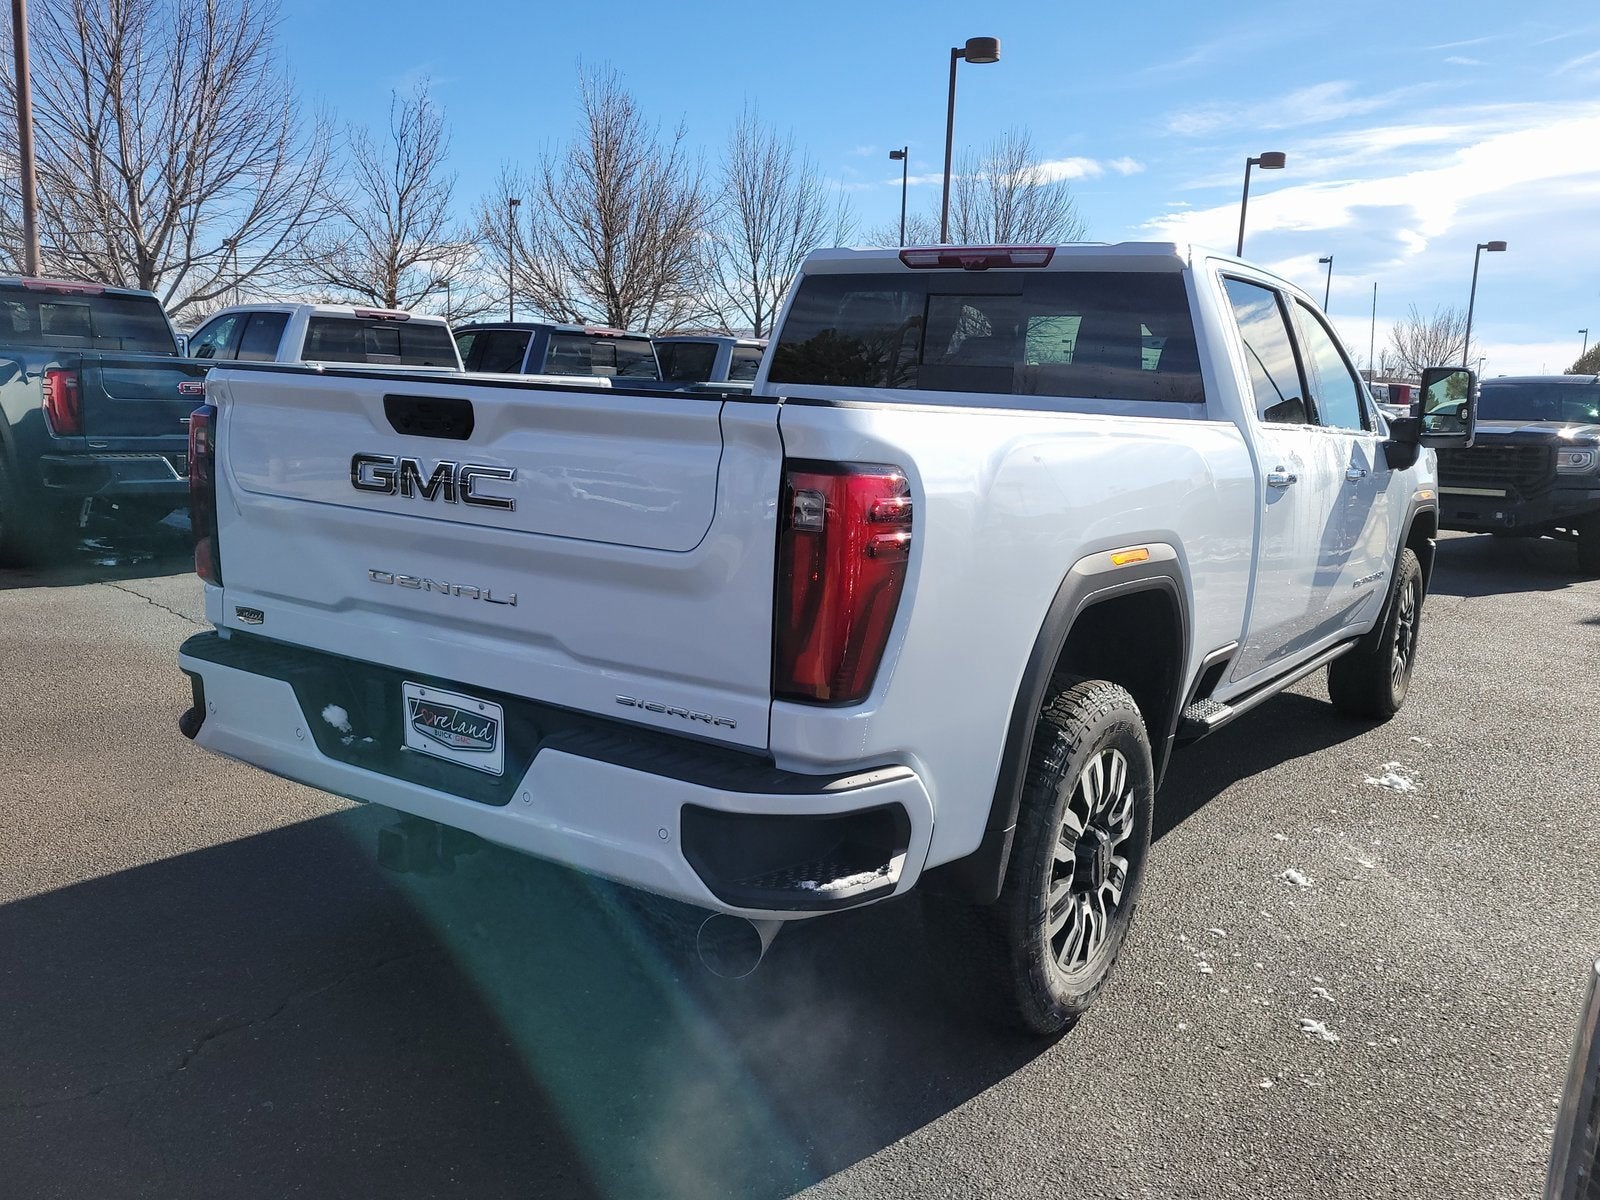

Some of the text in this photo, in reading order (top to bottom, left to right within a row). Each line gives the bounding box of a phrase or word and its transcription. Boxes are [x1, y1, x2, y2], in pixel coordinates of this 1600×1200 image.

[351, 452, 517, 512] GMC
[368, 568, 518, 606] DENALI
[615, 694, 737, 729] SIERRA
[434, 729, 453, 740] BUICK
